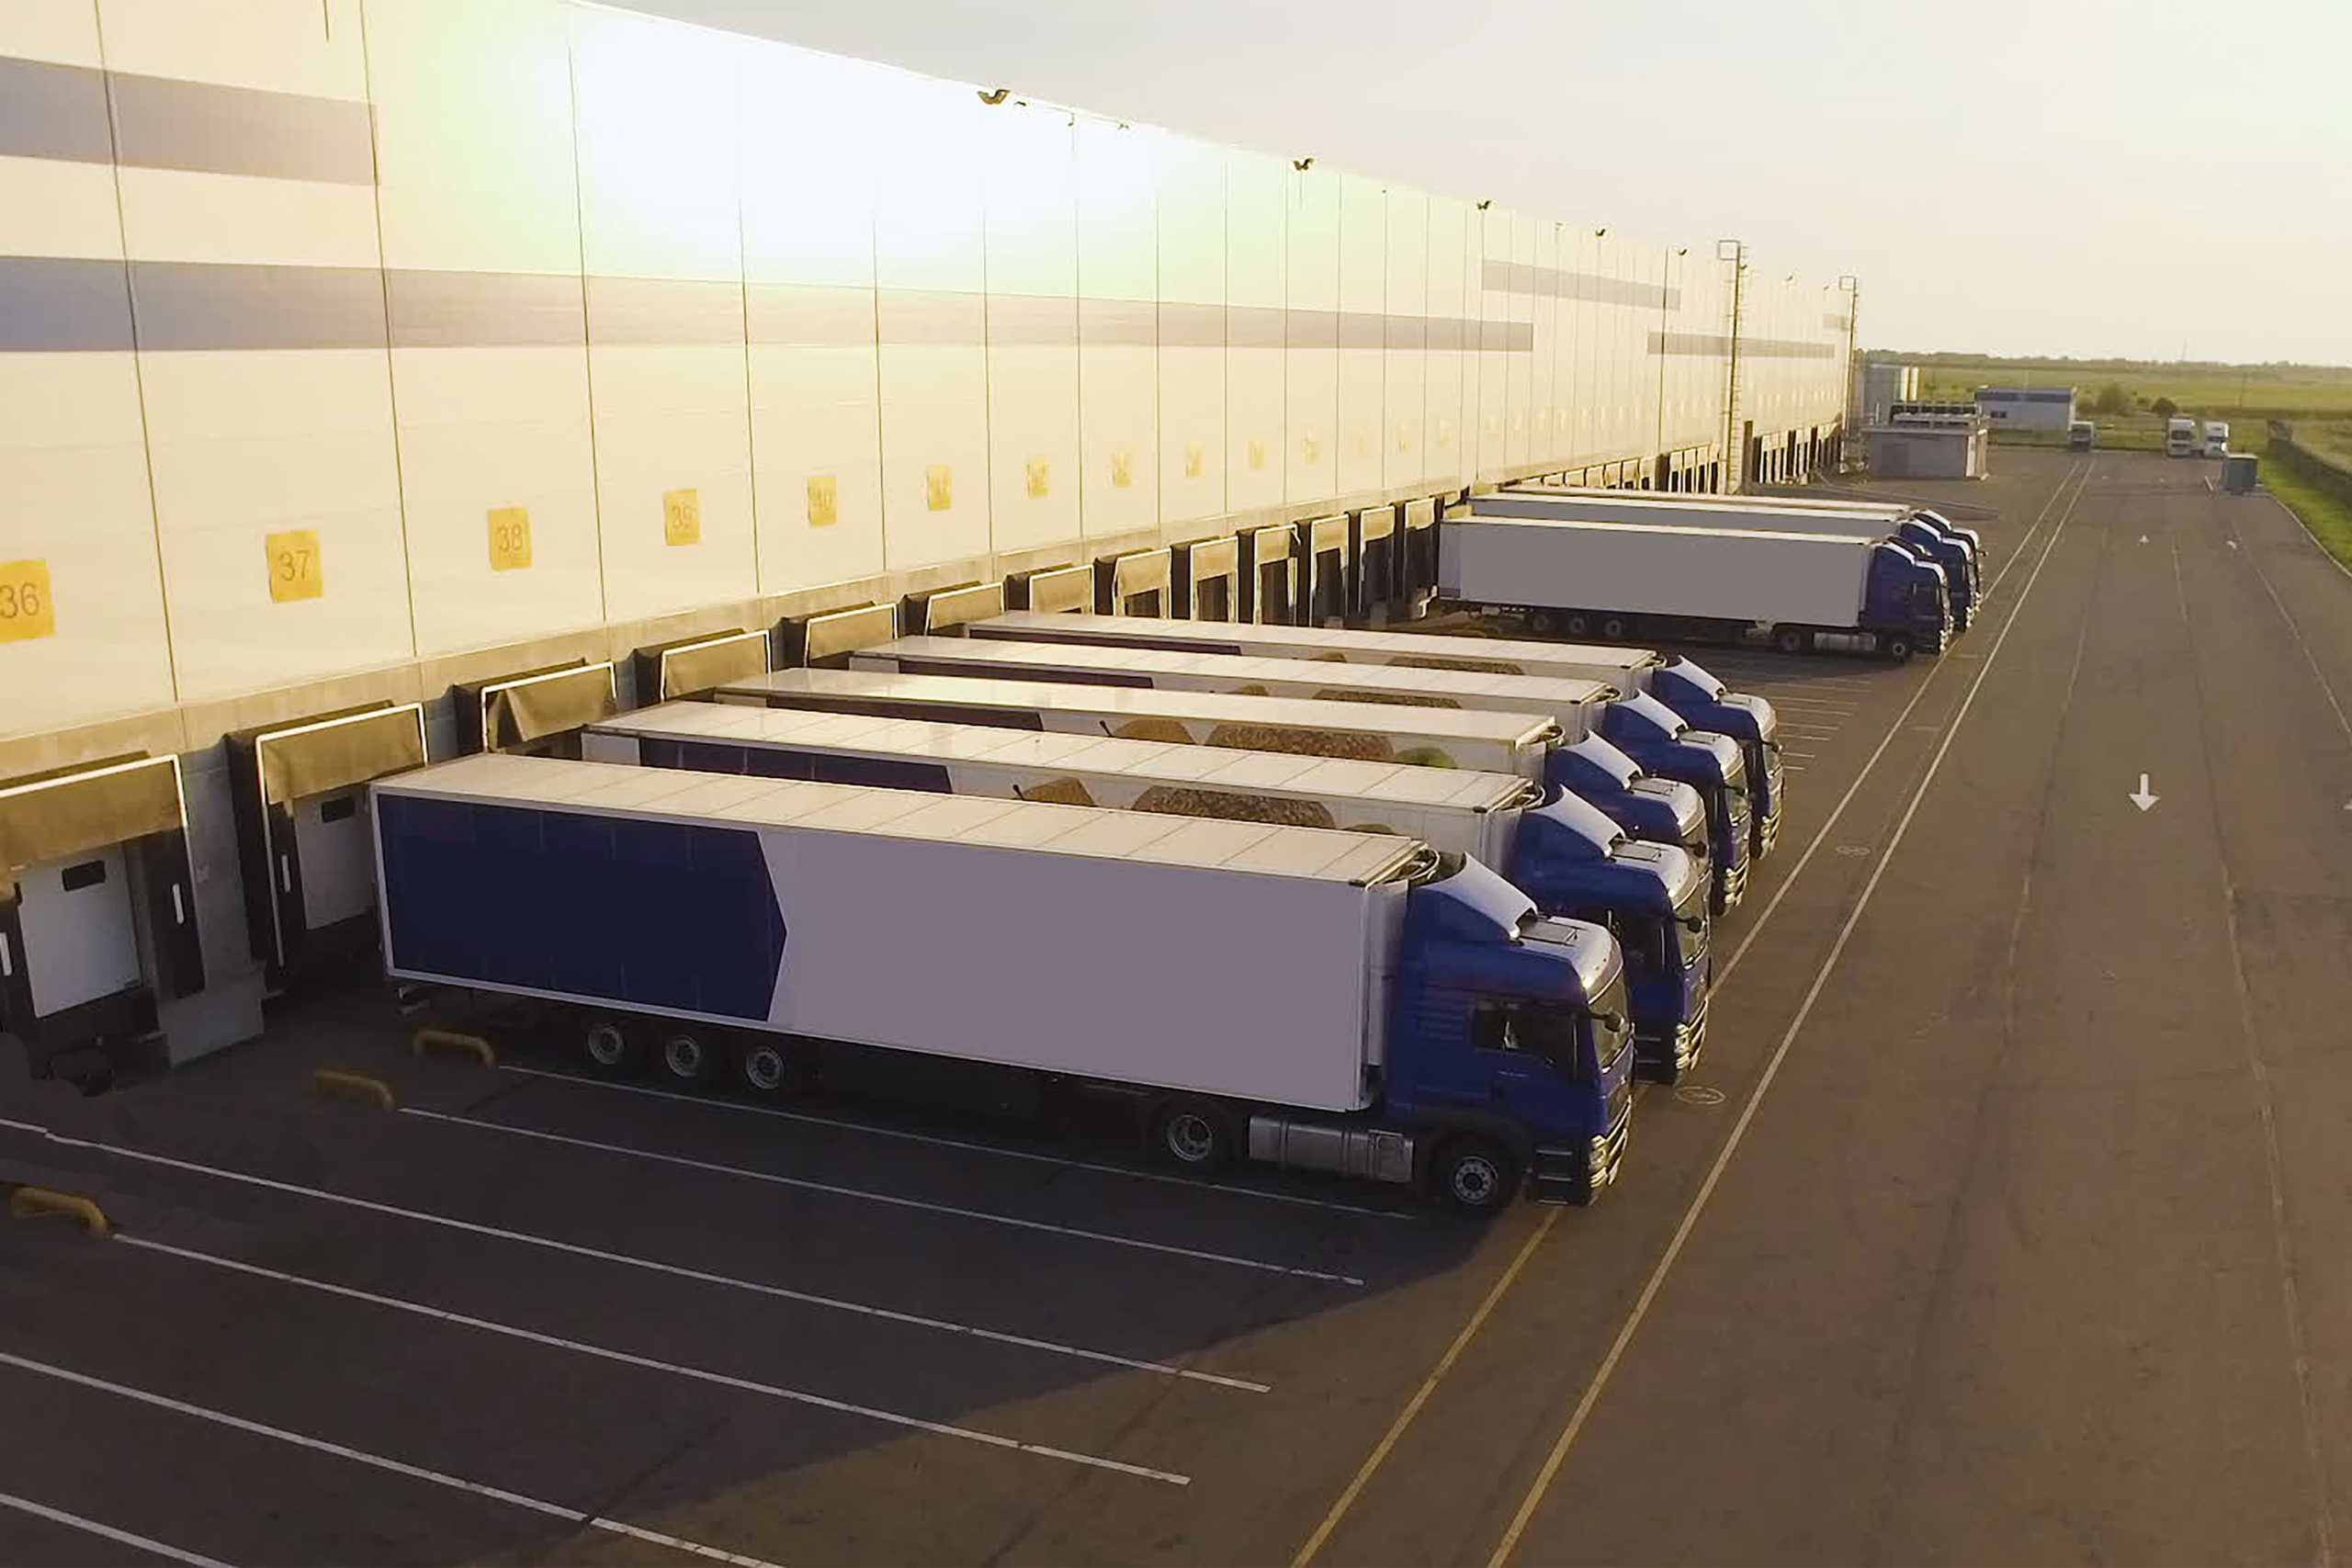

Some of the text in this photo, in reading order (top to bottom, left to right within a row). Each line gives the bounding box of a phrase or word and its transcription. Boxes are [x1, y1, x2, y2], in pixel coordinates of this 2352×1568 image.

[497, 524, 523, 552] 38
[277, 549, 310, 581] 37
[0, 582, 40, 618] 36
